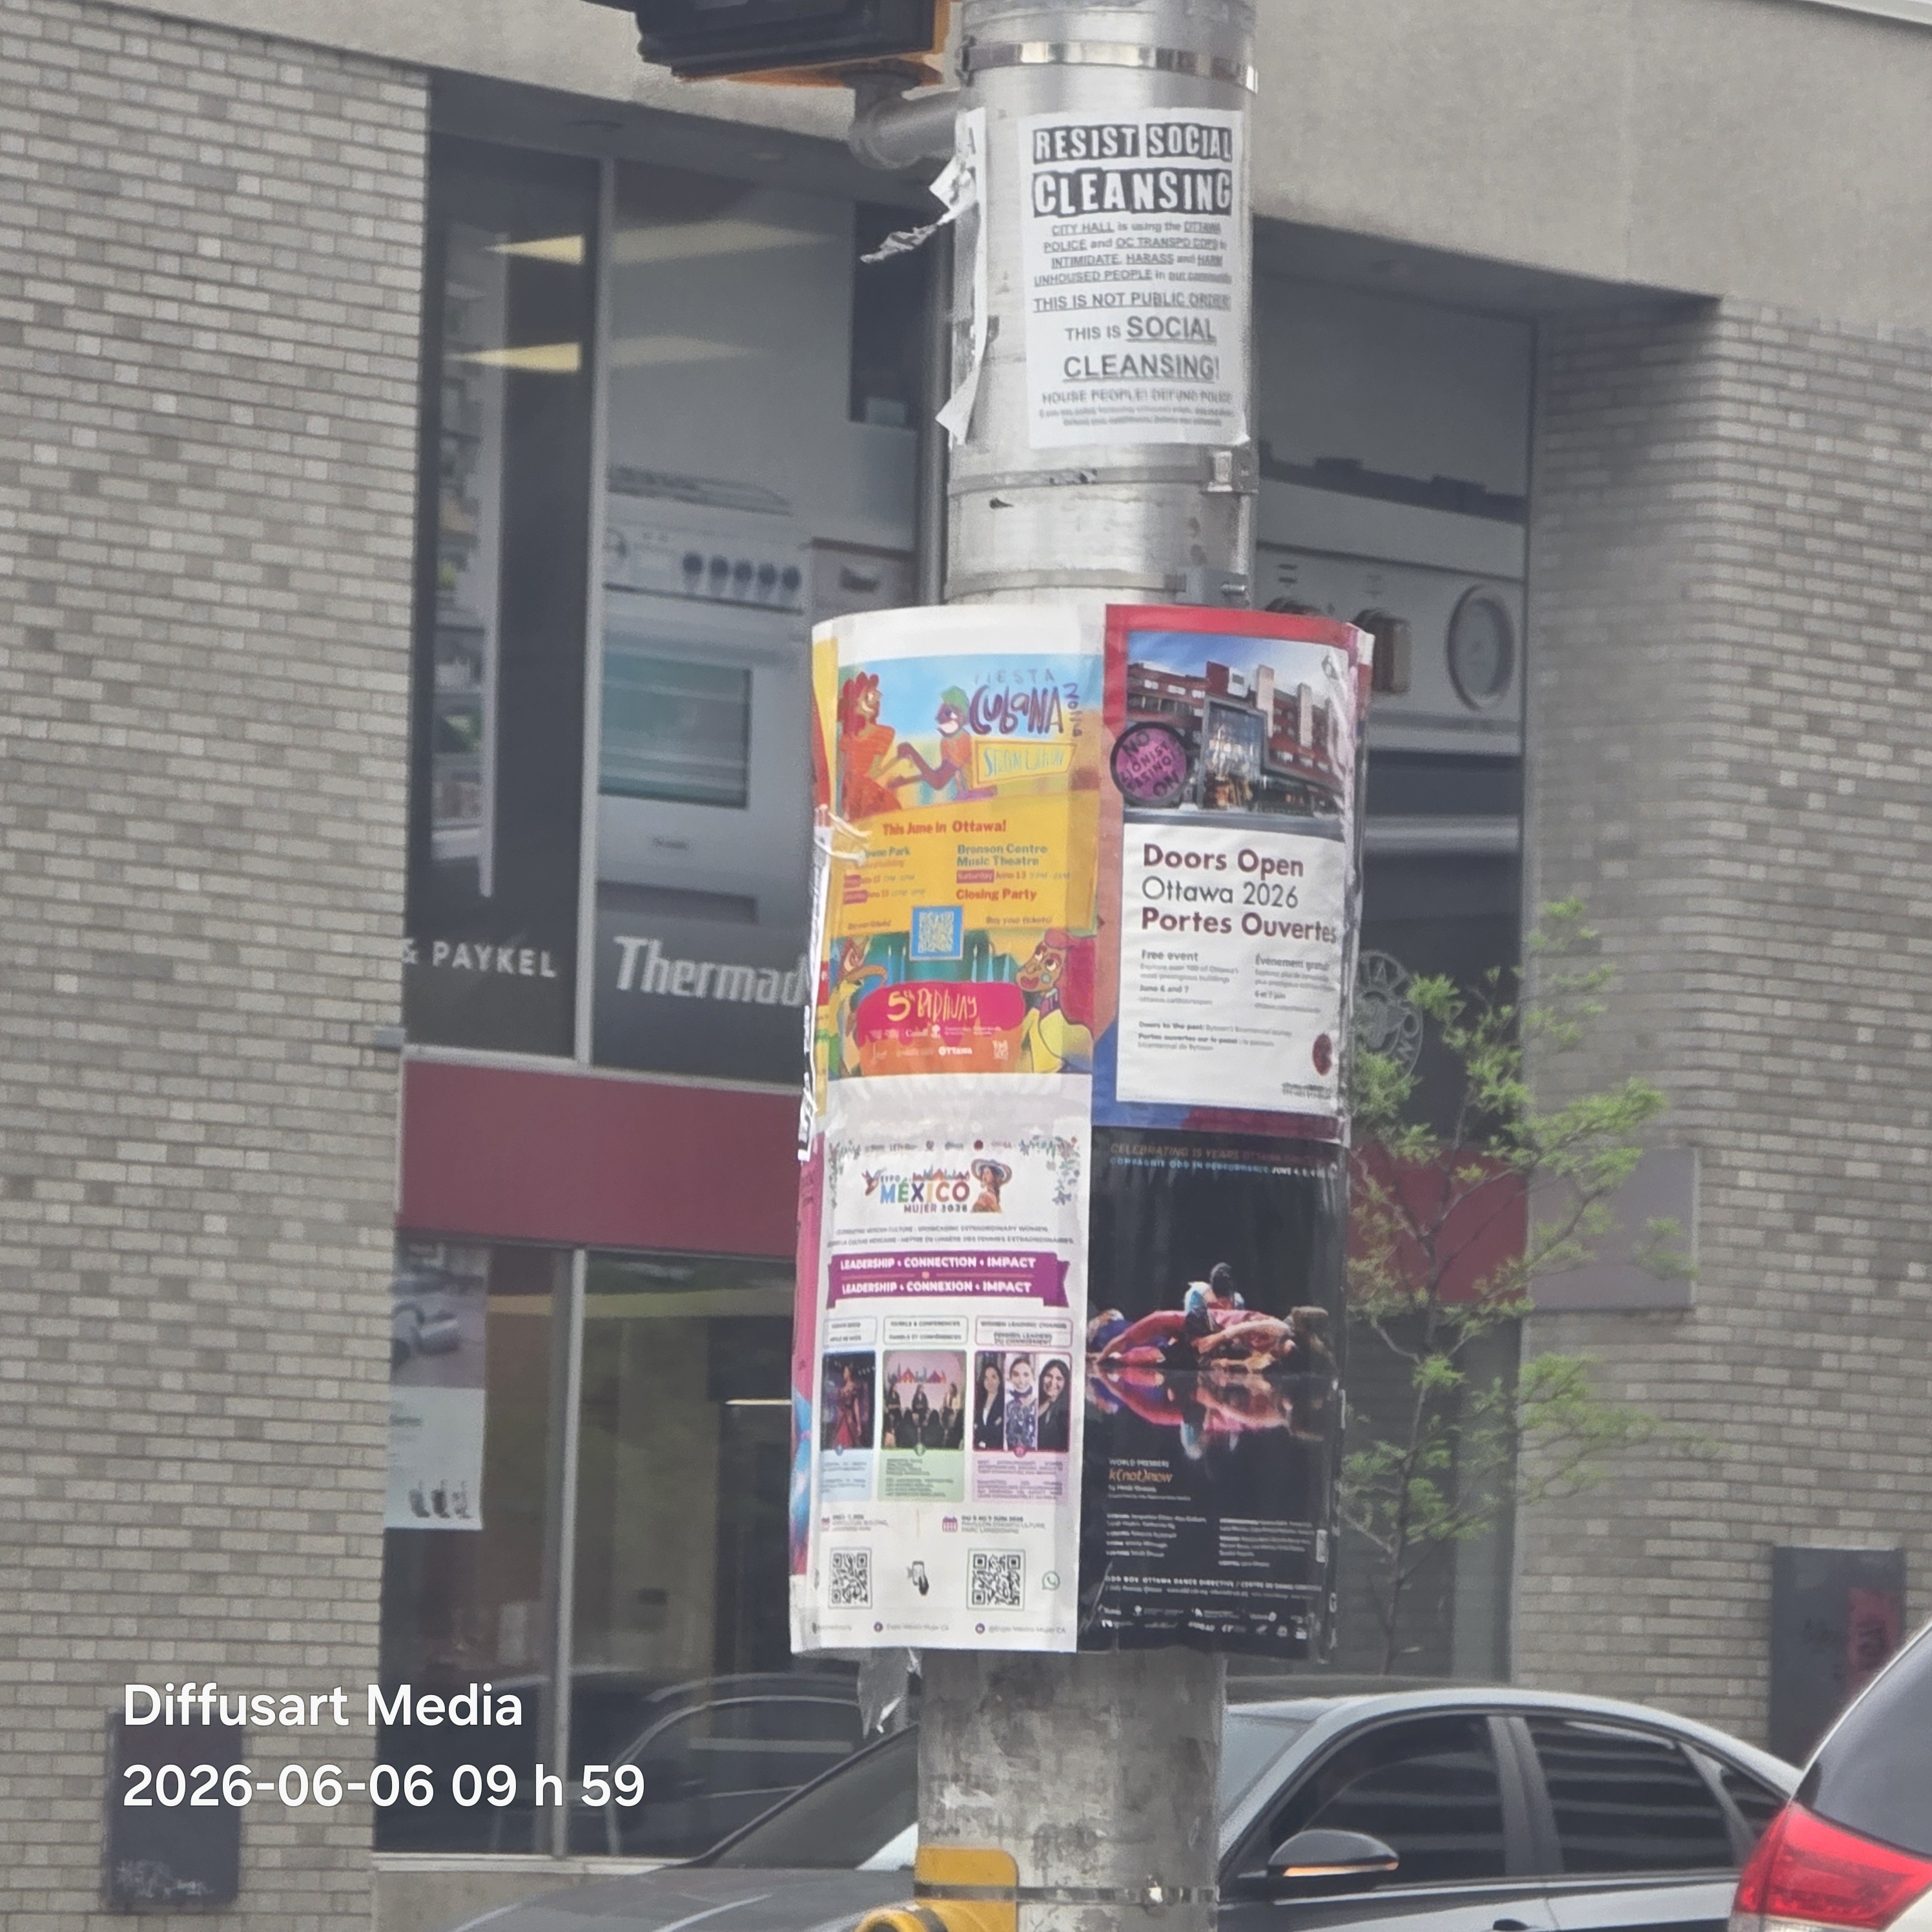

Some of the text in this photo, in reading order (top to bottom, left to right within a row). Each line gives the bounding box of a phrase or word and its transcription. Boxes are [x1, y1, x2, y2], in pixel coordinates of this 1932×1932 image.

[1035, 125, 1231, 161] RESIST SOCIAL
[1034, 170, 1231, 214] CLEANSING
[1052, 223, 1078, 235] CITY
[1082, 222, 1113, 233] HALL
[1117, 221, 1128, 231] is
[1043, 240, 1087, 253] POLICE
[1090, 238, 1113, 249] and
[1125, 253, 1174, 265] HARASS
[1034, 271, 1101, 287] UNHOUSED
[1104, 269, 1153, 282] PEOPLE
[1034, 296, 1067, 311] THIS
[1073, 294, 1087, 308] IS
[1093, 293, 1125, 308] NOT
[1131, 292, 1184, 308] PUBLIC
[1065, 316, 1217, 343] THIS IS SOCIAL
[1064, 354, 1220, 381] CLEANSING!
[883, 823, 905, 836] This
[907, 822, 933, 835] June
[957, 843, 1048, 854] Bronson Centre
[956, 856, 1040, 867] Music Theatre
[1143, 843, 1304, 881] Doors Open
[956, 888, 1037, 901] Closing Party
[1142, 875, 1299, 909] Ottawa 2026
[1142, 906, 1337, 944] Portes Ouvertes
[432, 941, 558, 978] PAYKEL
[1142, 949, 1198, 961] Free event
[880, 1177, 971, 1204] MÉXICO
[903, 1203, 937, 1215] MUJER
[840, 1256, 1036, 1271] LEADERSHIP CONNECTION IMPACT
[841, 1280, 1032, 1295] LEADERSHIP CONNEXION IMPACT
